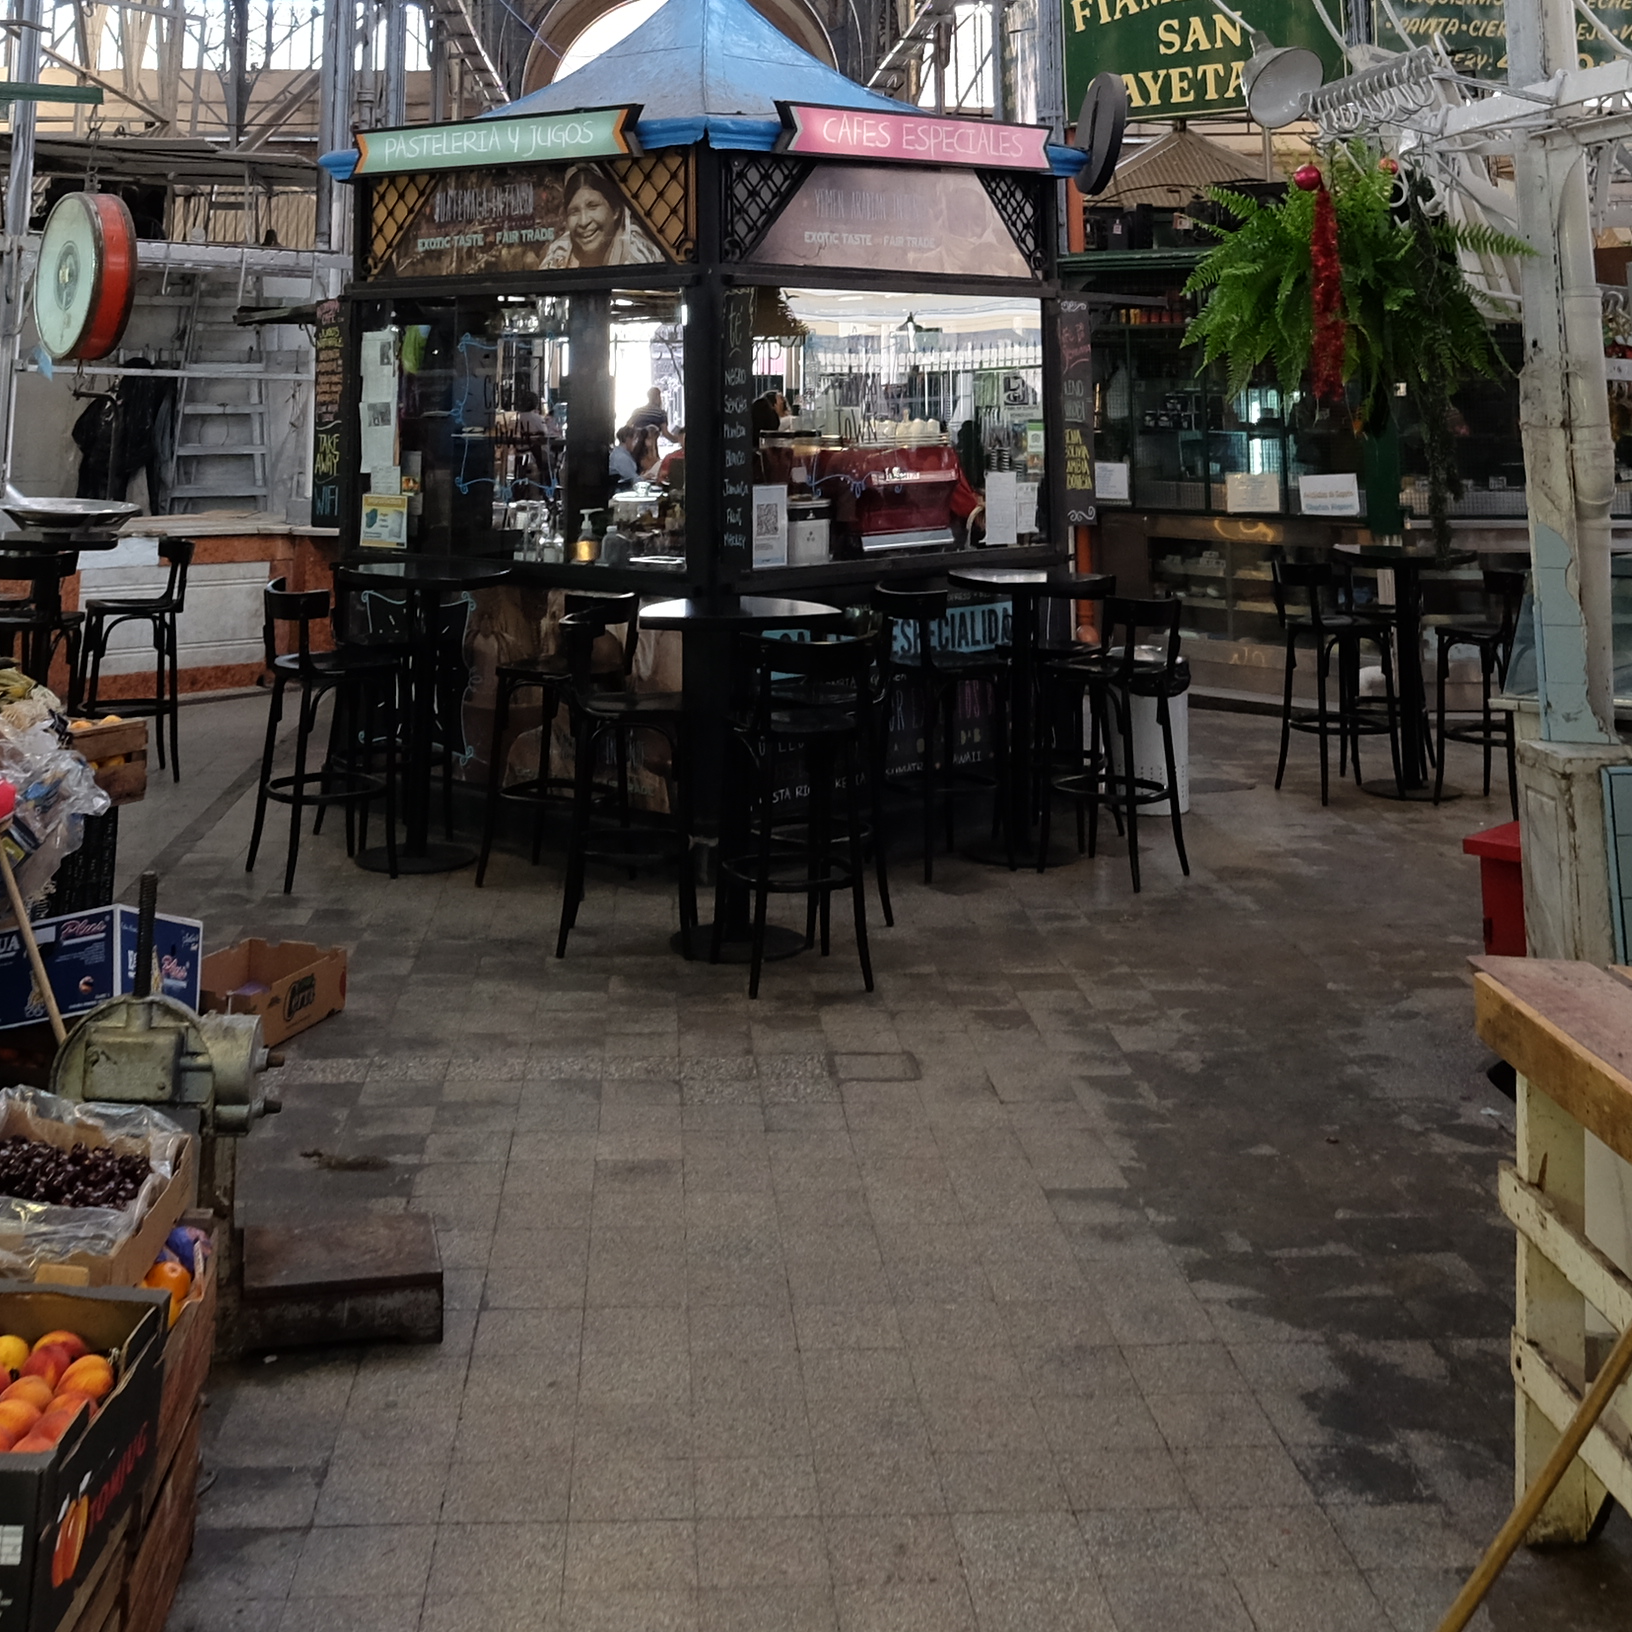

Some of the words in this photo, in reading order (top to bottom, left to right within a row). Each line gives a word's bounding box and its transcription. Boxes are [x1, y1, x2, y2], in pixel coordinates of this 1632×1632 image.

[1158, 10, 1243, 56] SAN
[384, 126, 501, 165] PASTELERIA
[522, 120, 595, 158] JUGOS
[822, 114, 891, 149] CAFES
[902, 123, 1024, 159] ESPECIALES
[453, 233, 484, 247] TASTE
[842, 232, 872, 246] TASTE
